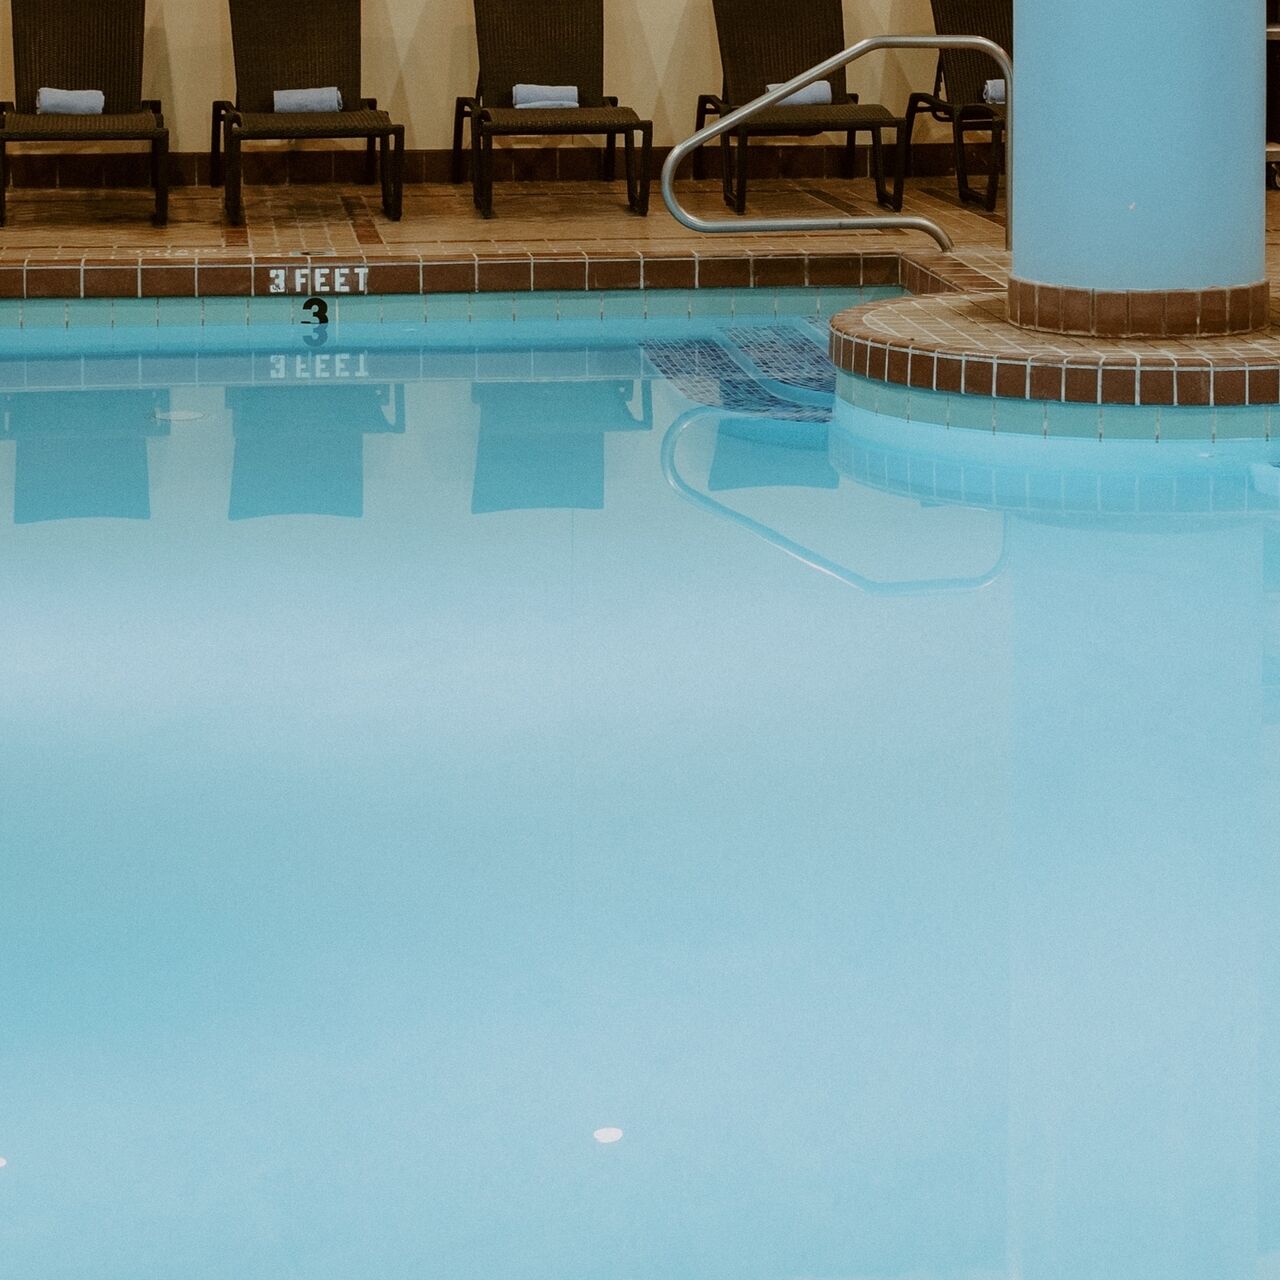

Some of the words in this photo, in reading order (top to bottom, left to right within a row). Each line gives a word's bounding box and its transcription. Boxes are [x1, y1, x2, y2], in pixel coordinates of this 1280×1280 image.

[269, 268, 286, 293] 3
[295, 267, 369, 292] FEET
[300, 297, 329, 325] 3
